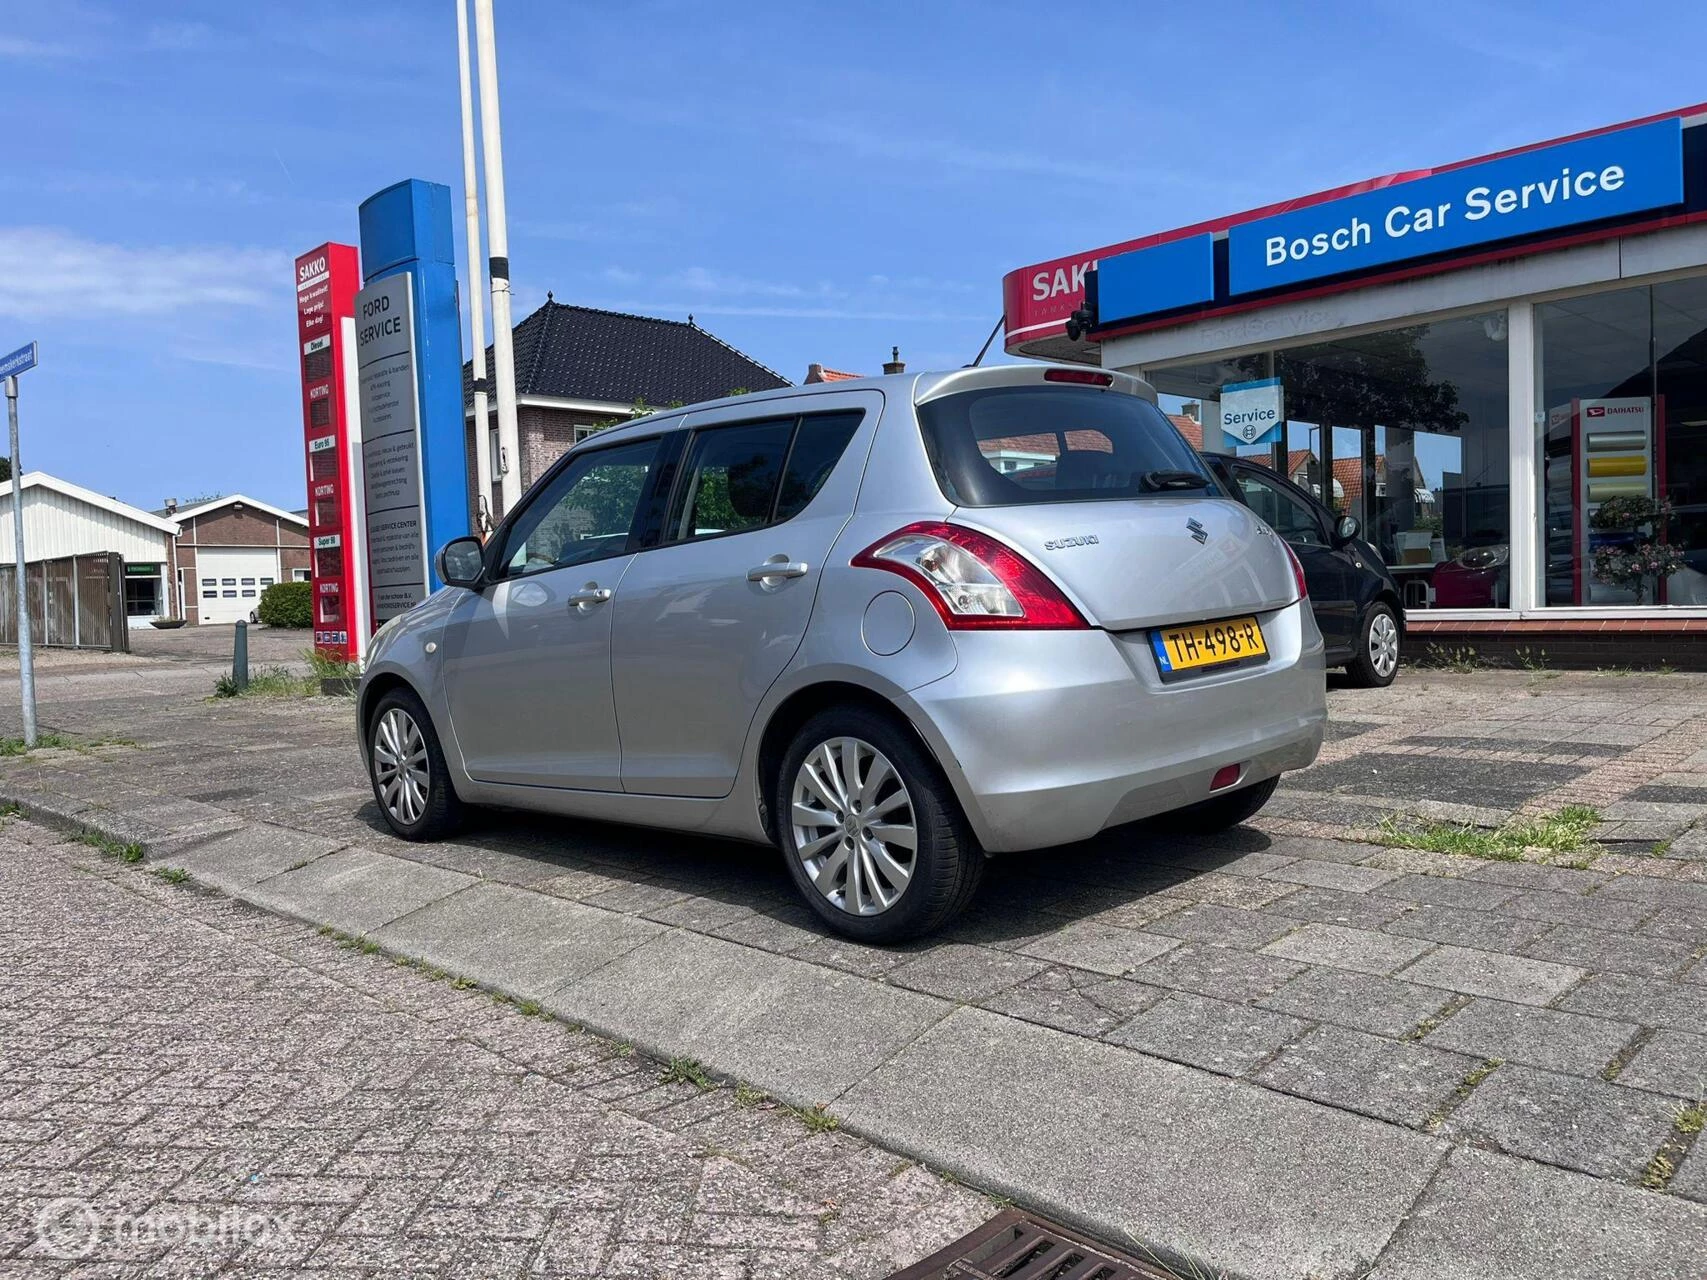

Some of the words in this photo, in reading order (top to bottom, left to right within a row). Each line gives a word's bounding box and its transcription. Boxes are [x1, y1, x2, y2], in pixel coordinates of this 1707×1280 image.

[1266, 217, 1371, 267] Bosch
[1385, 203, 1451, 238] Car
[1464, 165, 1625, 221] Service
[300, 256, 326, 281] SAKKO
[363, 295, 390, 320] FORD
[360, 316, 401, 346] SERVICE
[310, 339, 323, 351] Diesel
[310, 384, 329, 399] KORTING
[1224, 408, 1275, 425] Service
[1607, 407, 1644, 415] DAIHATSU
[314, 440, 324, 450] Euro
[314, 484, 334, 497] KORTING
[396, 520, 417, 529] CENTER
[318, 536, 328, 546] Super
[1044, 535, 1099, 551] SUZUKI
[319, 583, 339, 593] KORTING
[1168, 623, 1259, 663] TH-498-R
